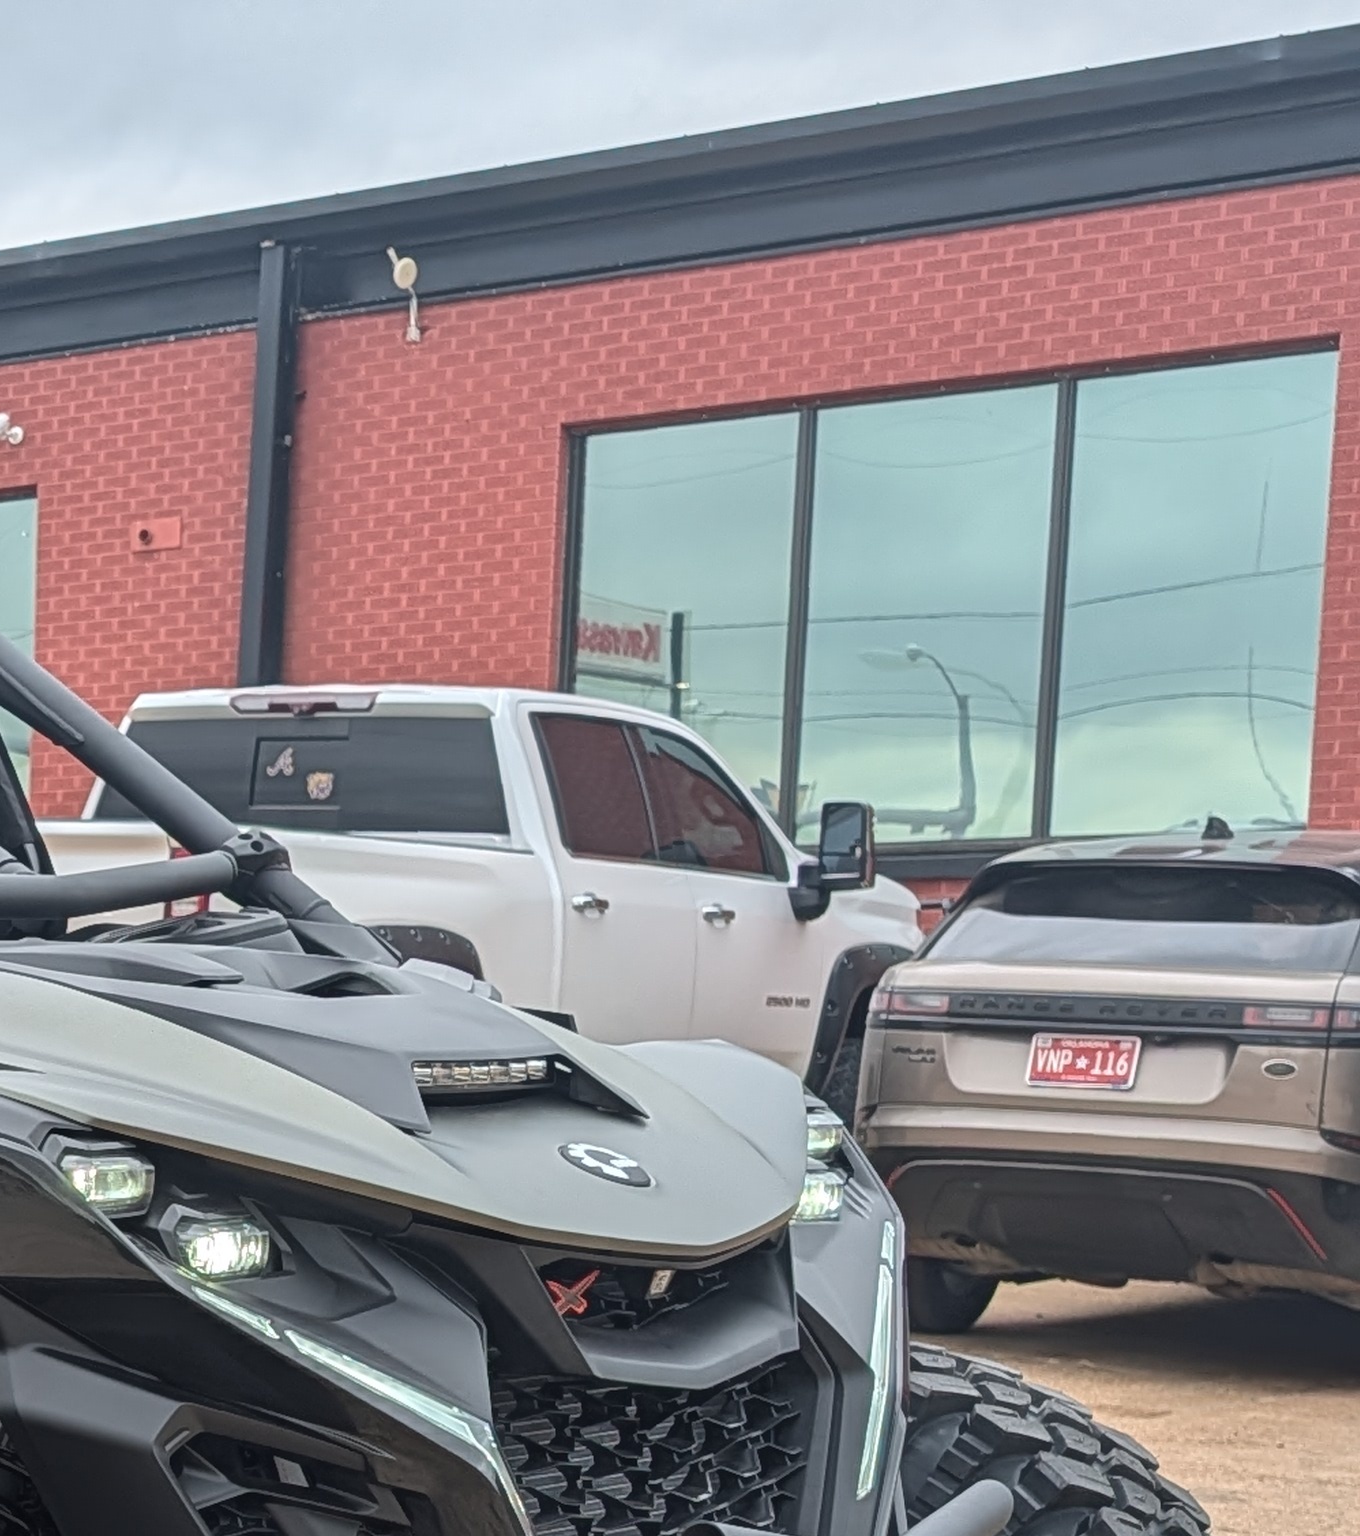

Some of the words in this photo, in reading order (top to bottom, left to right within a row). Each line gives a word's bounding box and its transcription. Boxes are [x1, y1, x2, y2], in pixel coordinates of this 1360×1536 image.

[959, 995, 1075, 1013] RANGE
[1098, 1002, 1228, 1019] ROVER
[1036, 1048, 1073, 1074] VNP
[1090, 1050, 1129, 1076] 116
